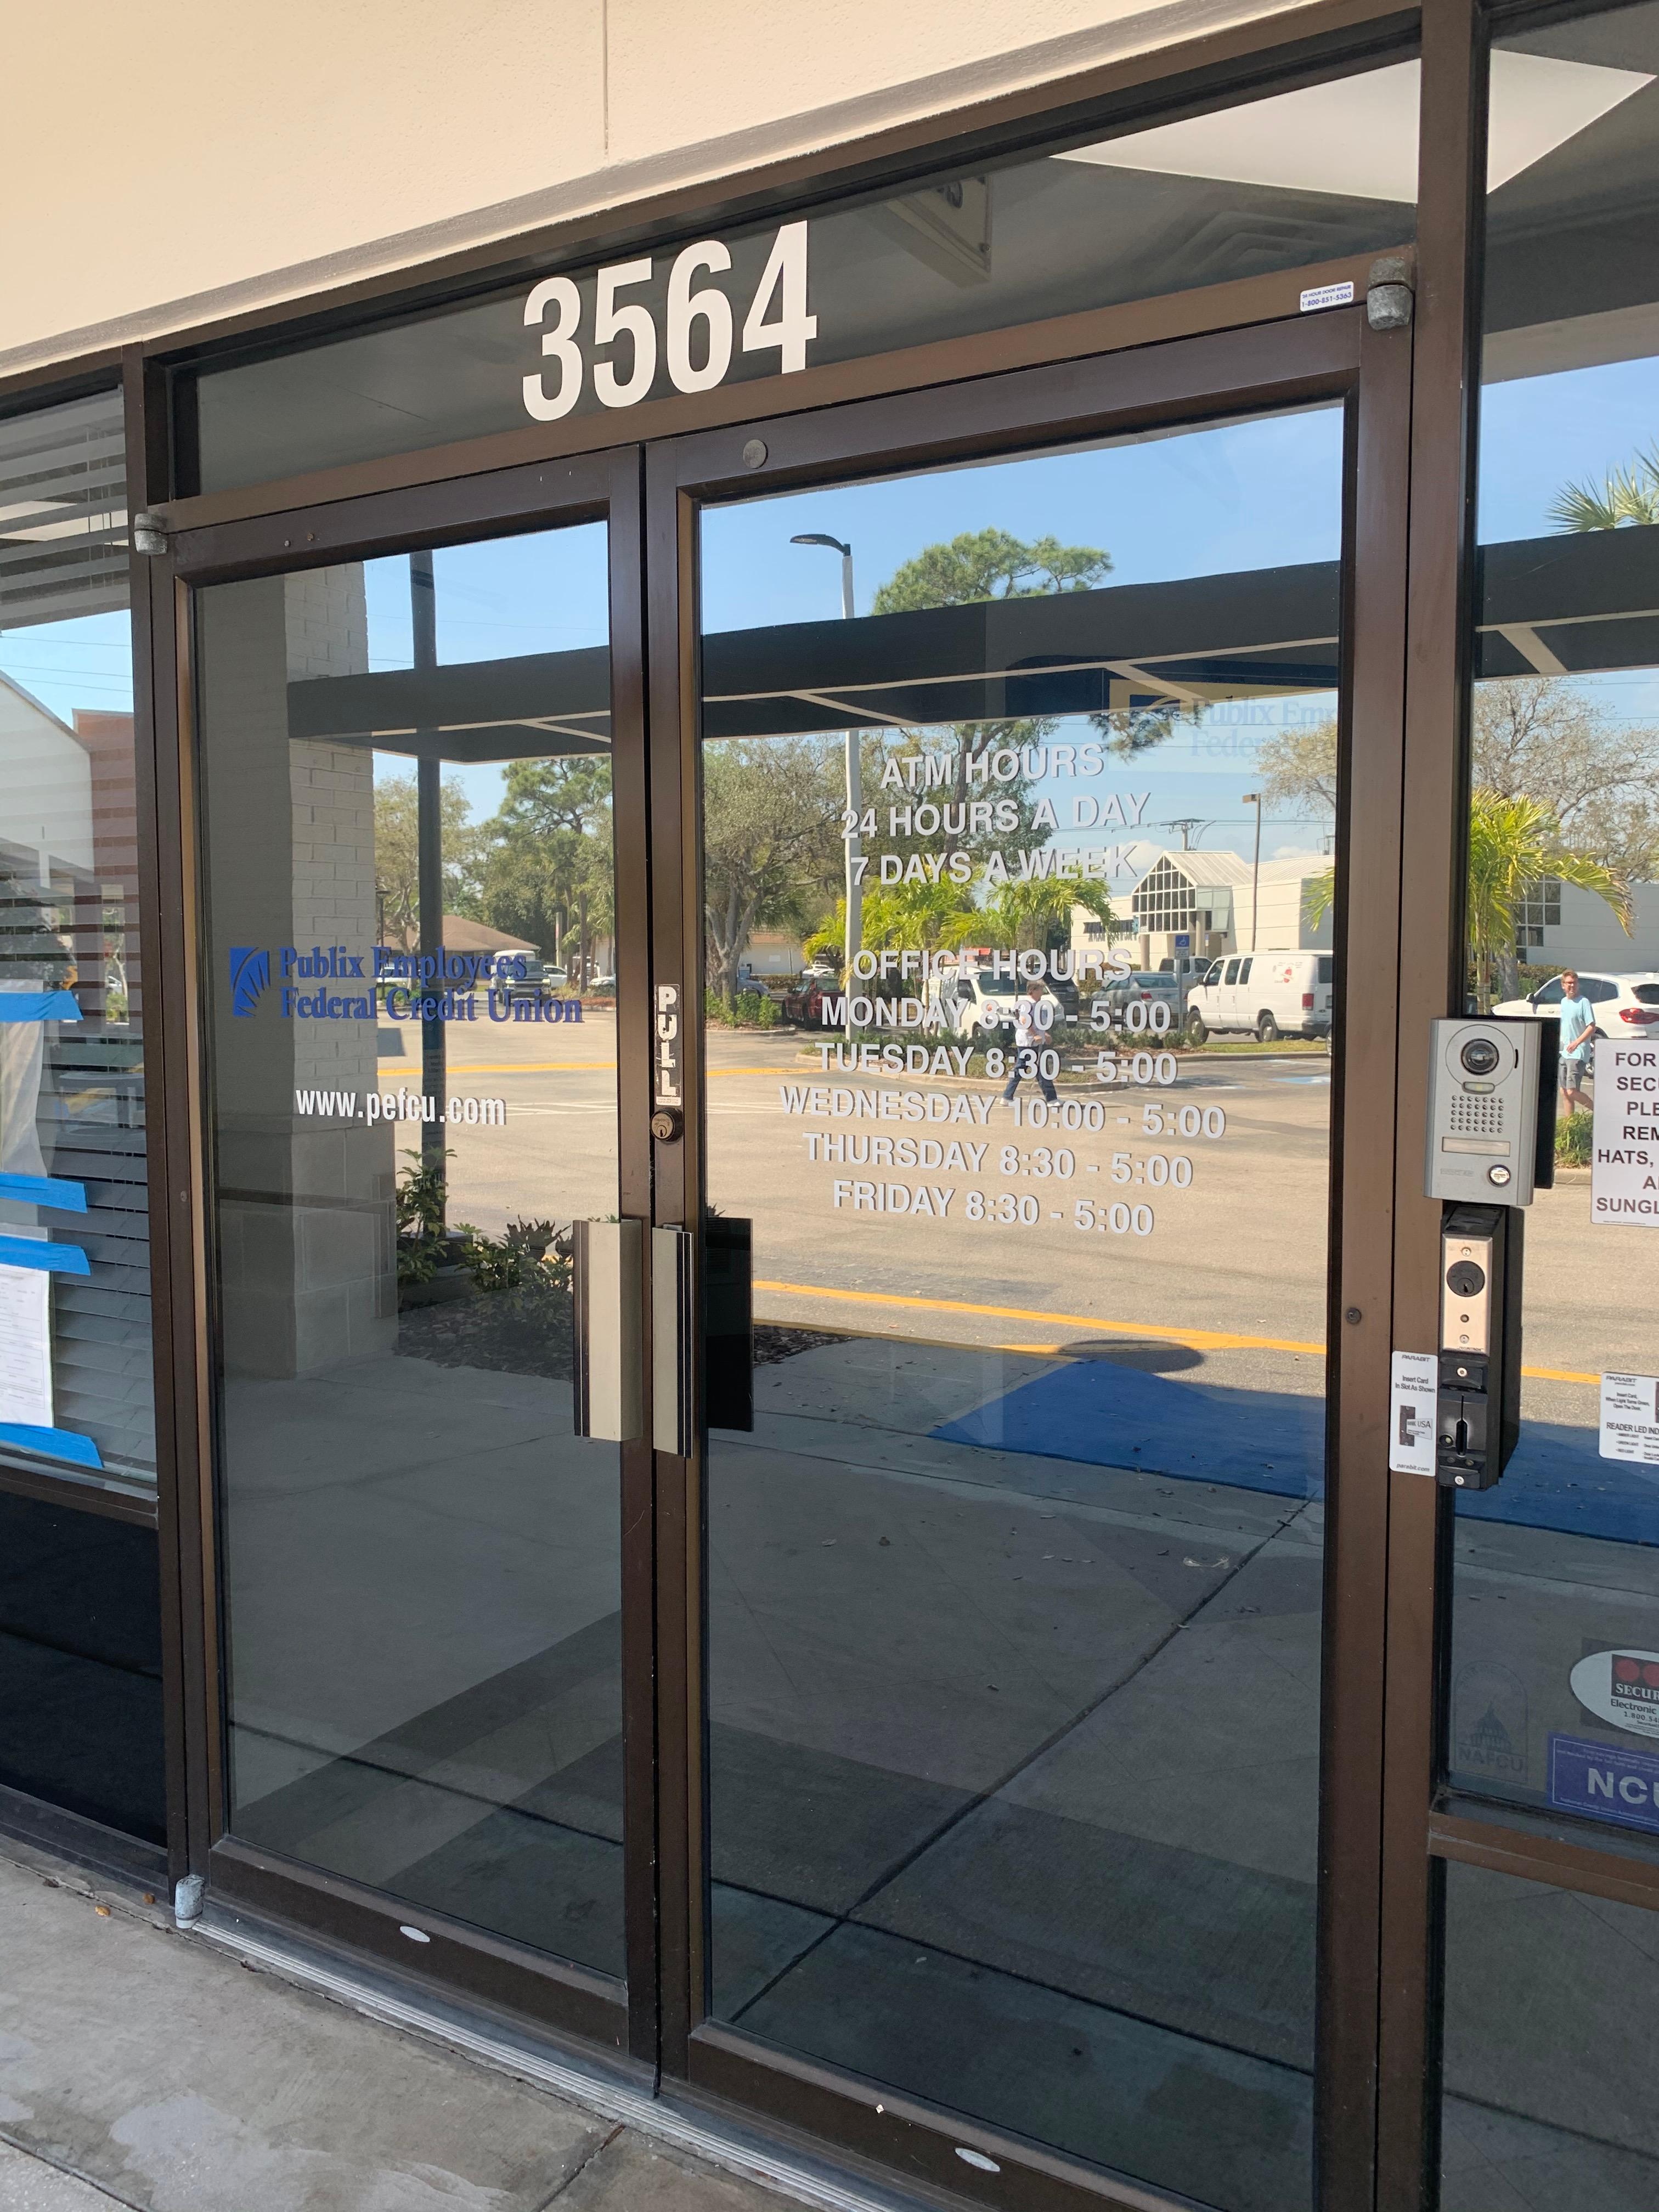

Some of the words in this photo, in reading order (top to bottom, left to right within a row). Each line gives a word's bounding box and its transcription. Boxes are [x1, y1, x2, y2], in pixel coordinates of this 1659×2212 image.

[1302, 292, 1352, 308] 1-800-851-5363
[522, 220, 817, 421] 3564
[880, 754, 952, 789] ATM
[966, 743, 1104, 783] HOURS
[841, 808, 878, 839] 24
[890, 800, 1019, 837] HOURS
[1031, 798, 1059, 830] A
[1073, 792, 1151, 828] DAY
[851, 857, 869, 885] 7
[881, 851, 972, 885] DAYS
[985, 851, 1010, 881] A
[1018, 845, 1138, 881] WEEK
[279, 946, 364, 979] Publix
[370, 945, 527, 988] Employees
[853, 950, 979, 980] OFFICE
[993, 948, 1132, 981] HOURS
[280, 988, 378, 1018] Federal
[386, 988, 479, 1022] Credit
[488, 988, 585, 1023] Union
[822, 996, 968, 1028] MONDAY
[979, 1000, 1054, 1031] 8:30
[1090, 1000, 1171, 1033] 5:00
[657, 986, 678, 1097] PULL
[1615, 1052, 1657, 1066] FOR
[815, 1042, 974, 1076] TUESDAY
[985, 1047, 1060, 1081] 8:30
[1096, 1051, 1178, 1085] 5:00
[1616, 1076, 1659, 1092] SEC
[295, 1087, 507, 1126] www.pefcu.com
[779, 1086, 997, 1125] WEDNESDAY
[1008, 1097, 1105, 1132] 10:00
[1142, 1103, 1226, 1139] 5:00
[802, 1132, 989, 1172] THURSDAY
[999, 1145, 1075, 1180] 8:30
[1110, 1152, 1193, 1188] 5:00
[1598, 1149, 1654, 1167] HATS,
[1643, 1176, 1659, 1190] A
[833, 1179, 956, 1217] FRIDAY
[965, 1190, 1040, 1226] 8:30
[1074, 1199, 1154, 1236] 5:00
[1418, 1420, 1431, 1429] USA
[1606, 1422, 1633, 1431] READER
[1396, 1463, 1430, 1471] parabit.com
[1611, 1699, 1657, 1714] Electronic
[1588, 1768, 1659, 1809] NC
